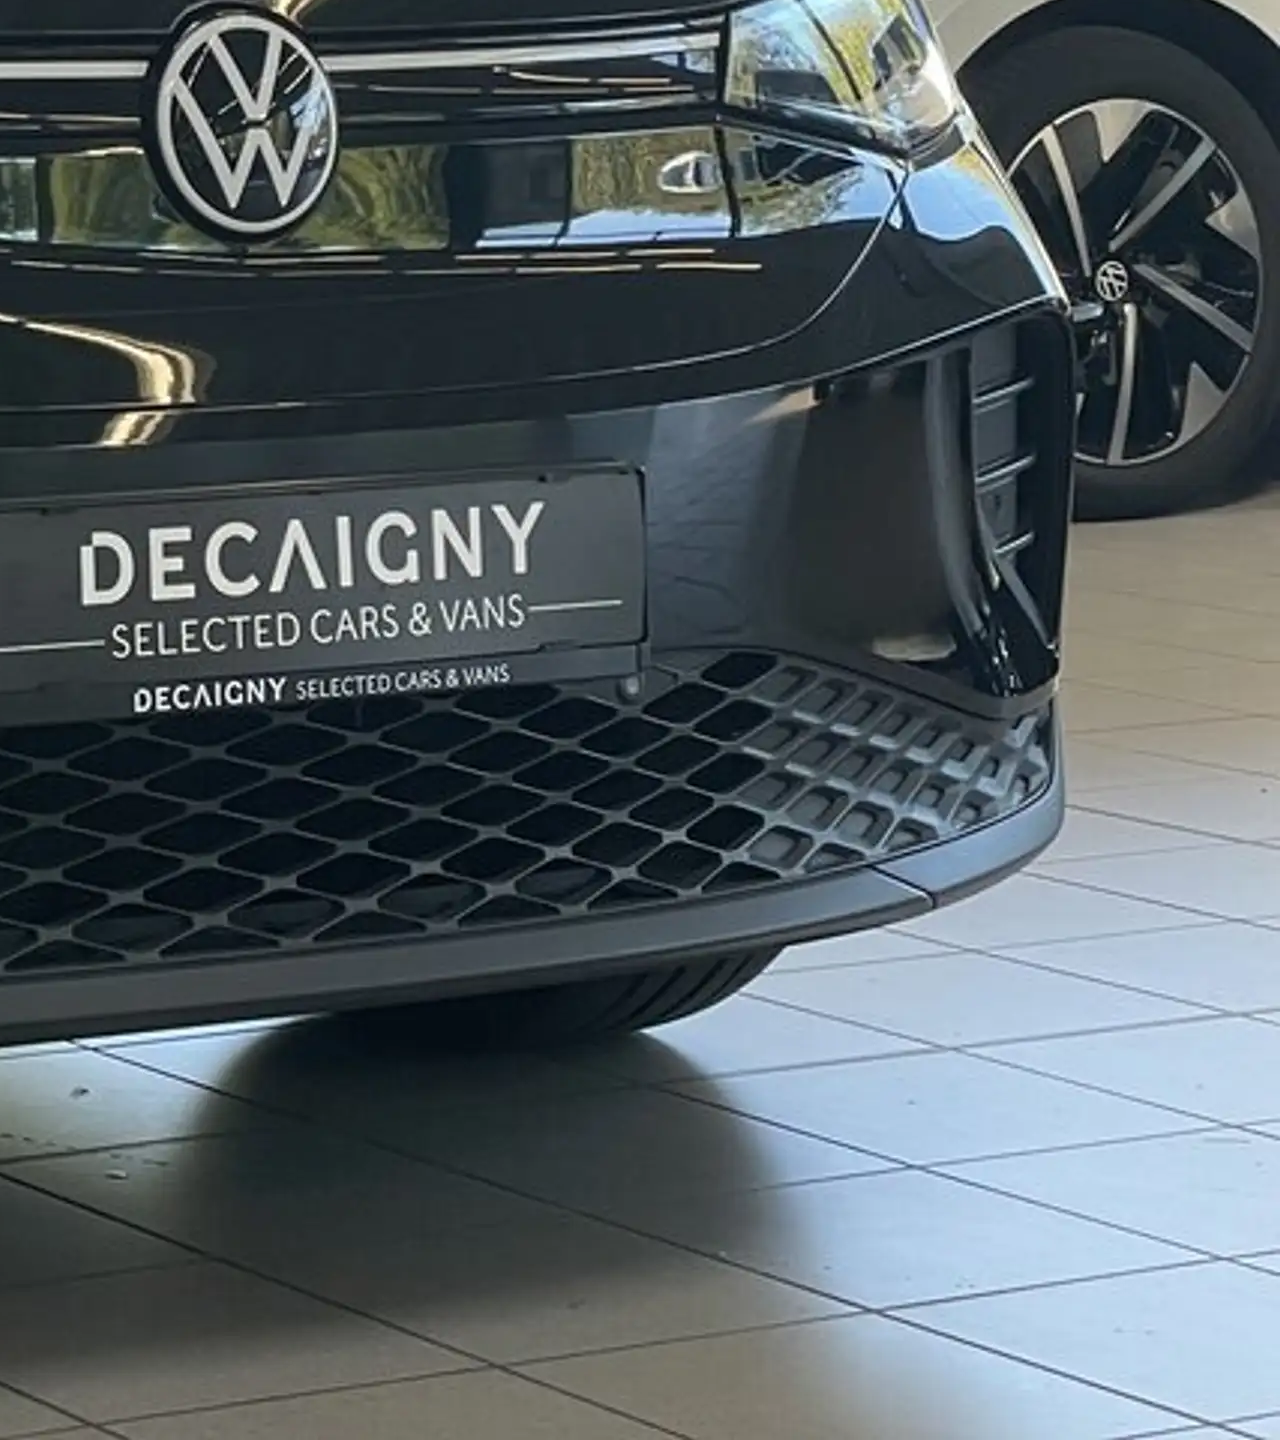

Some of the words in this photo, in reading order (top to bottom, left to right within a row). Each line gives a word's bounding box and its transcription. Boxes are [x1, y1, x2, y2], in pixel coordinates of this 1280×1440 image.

[79, 501, 544, 607] DECAIGNY
[111, 612, 301, 659] SELECTED
[310, 603, 400, 645] CARS
[409, 602, 432, 636] &
[439, 594, 527, 632] VANS
[133, 677, 288, 714] DECAIGNY
[295, 672, 390, 701] SELECTED
[394, 668, 441, 692] CARS
[445, 667, 459, 688] &
[462, 663, 510, 685] VANS
